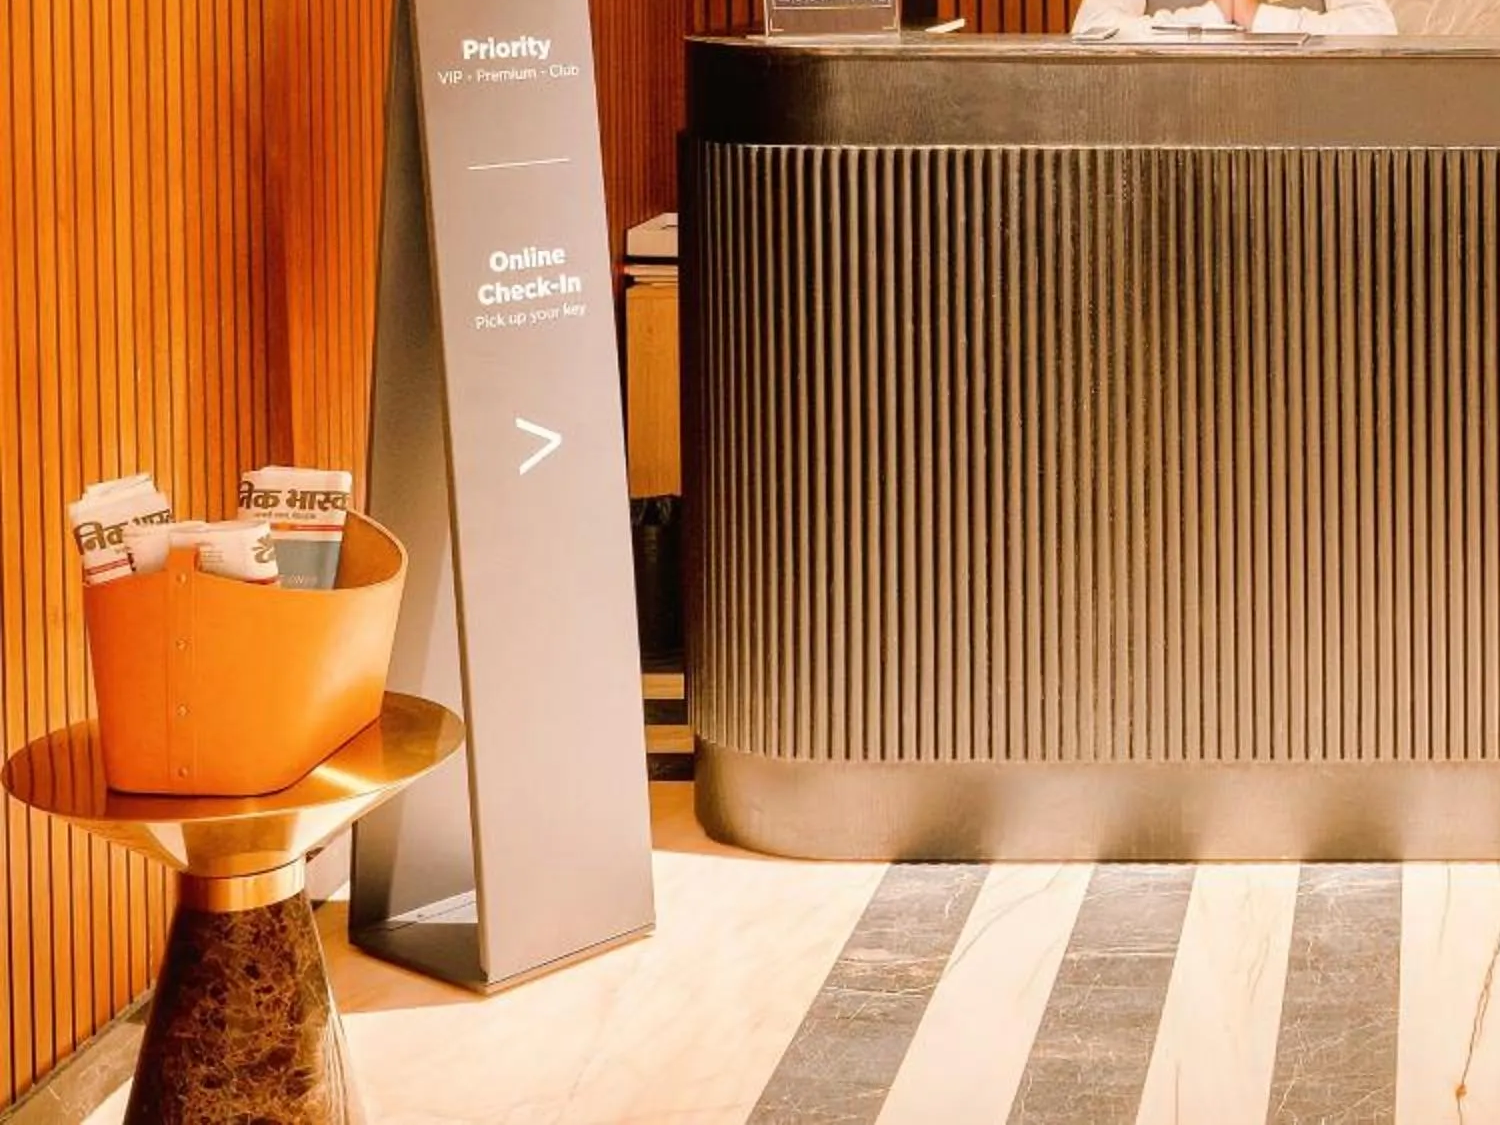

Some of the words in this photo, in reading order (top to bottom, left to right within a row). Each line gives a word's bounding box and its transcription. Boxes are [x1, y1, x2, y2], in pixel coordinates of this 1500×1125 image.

[462, 35, 551, 60] Priority
[437, 70, 463, 85] VIP
[476, 67, 537, 83] Premium
[549, 63, 580, 78] Club
[489, 246, 566, 272] Online
[478, 273, 582, 305] Check-In
[475, 313, 507, 329] Pick
[509, 311, 527, 327] up
[530, 307, 560, 324] your
[563, 302, 587, 317] key
